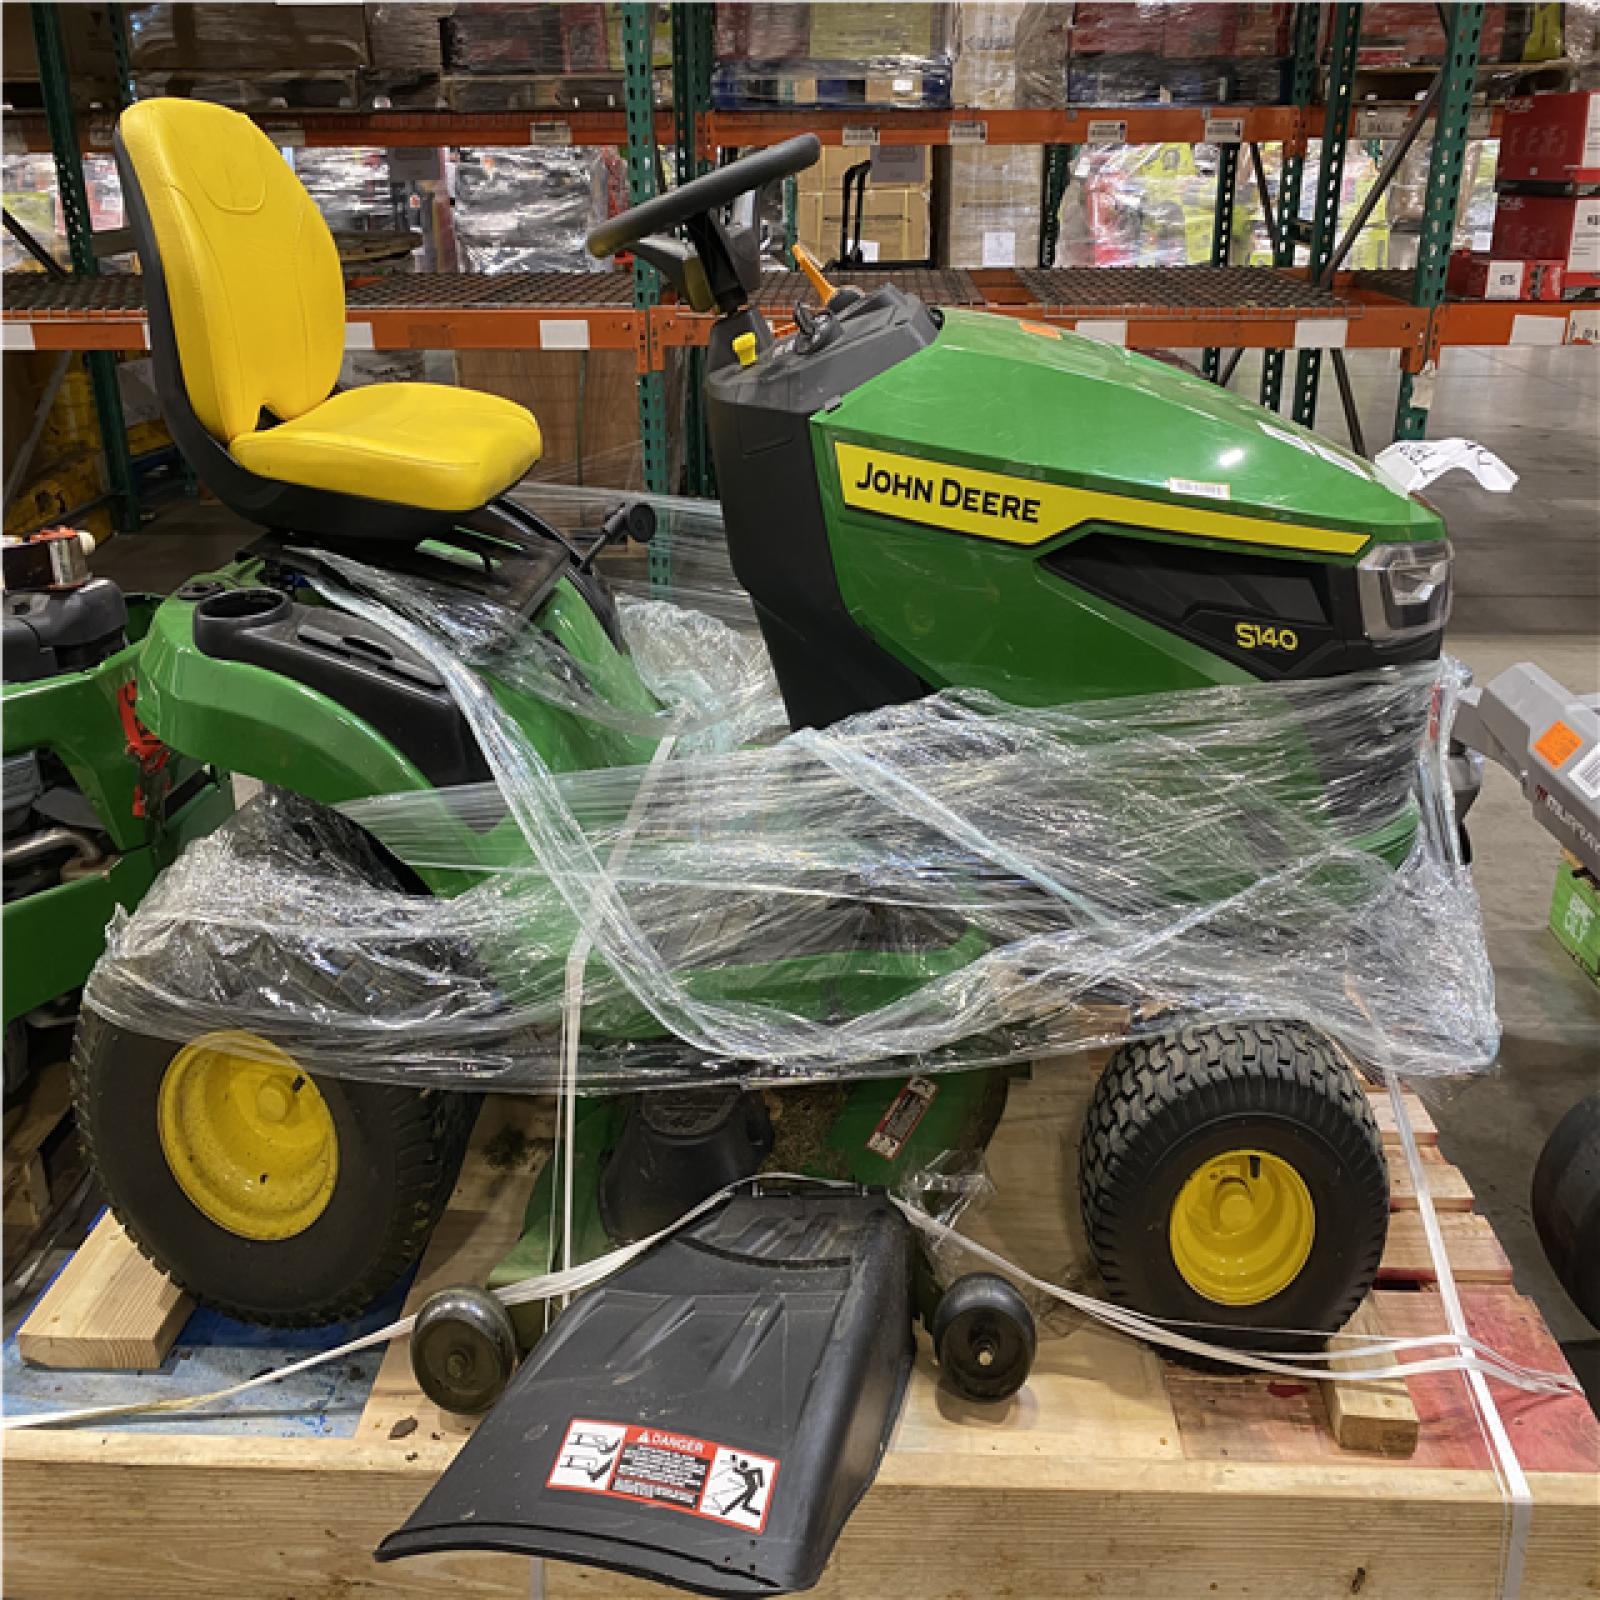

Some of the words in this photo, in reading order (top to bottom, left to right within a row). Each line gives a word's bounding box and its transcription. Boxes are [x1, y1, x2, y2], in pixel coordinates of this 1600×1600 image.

[856, 462, 934, 503] JOHN
[939, 477, 1041, 523] DEERE
[1235, 622, 1298, 651] S140
[651, 1431, 704, 1454] DANGER
